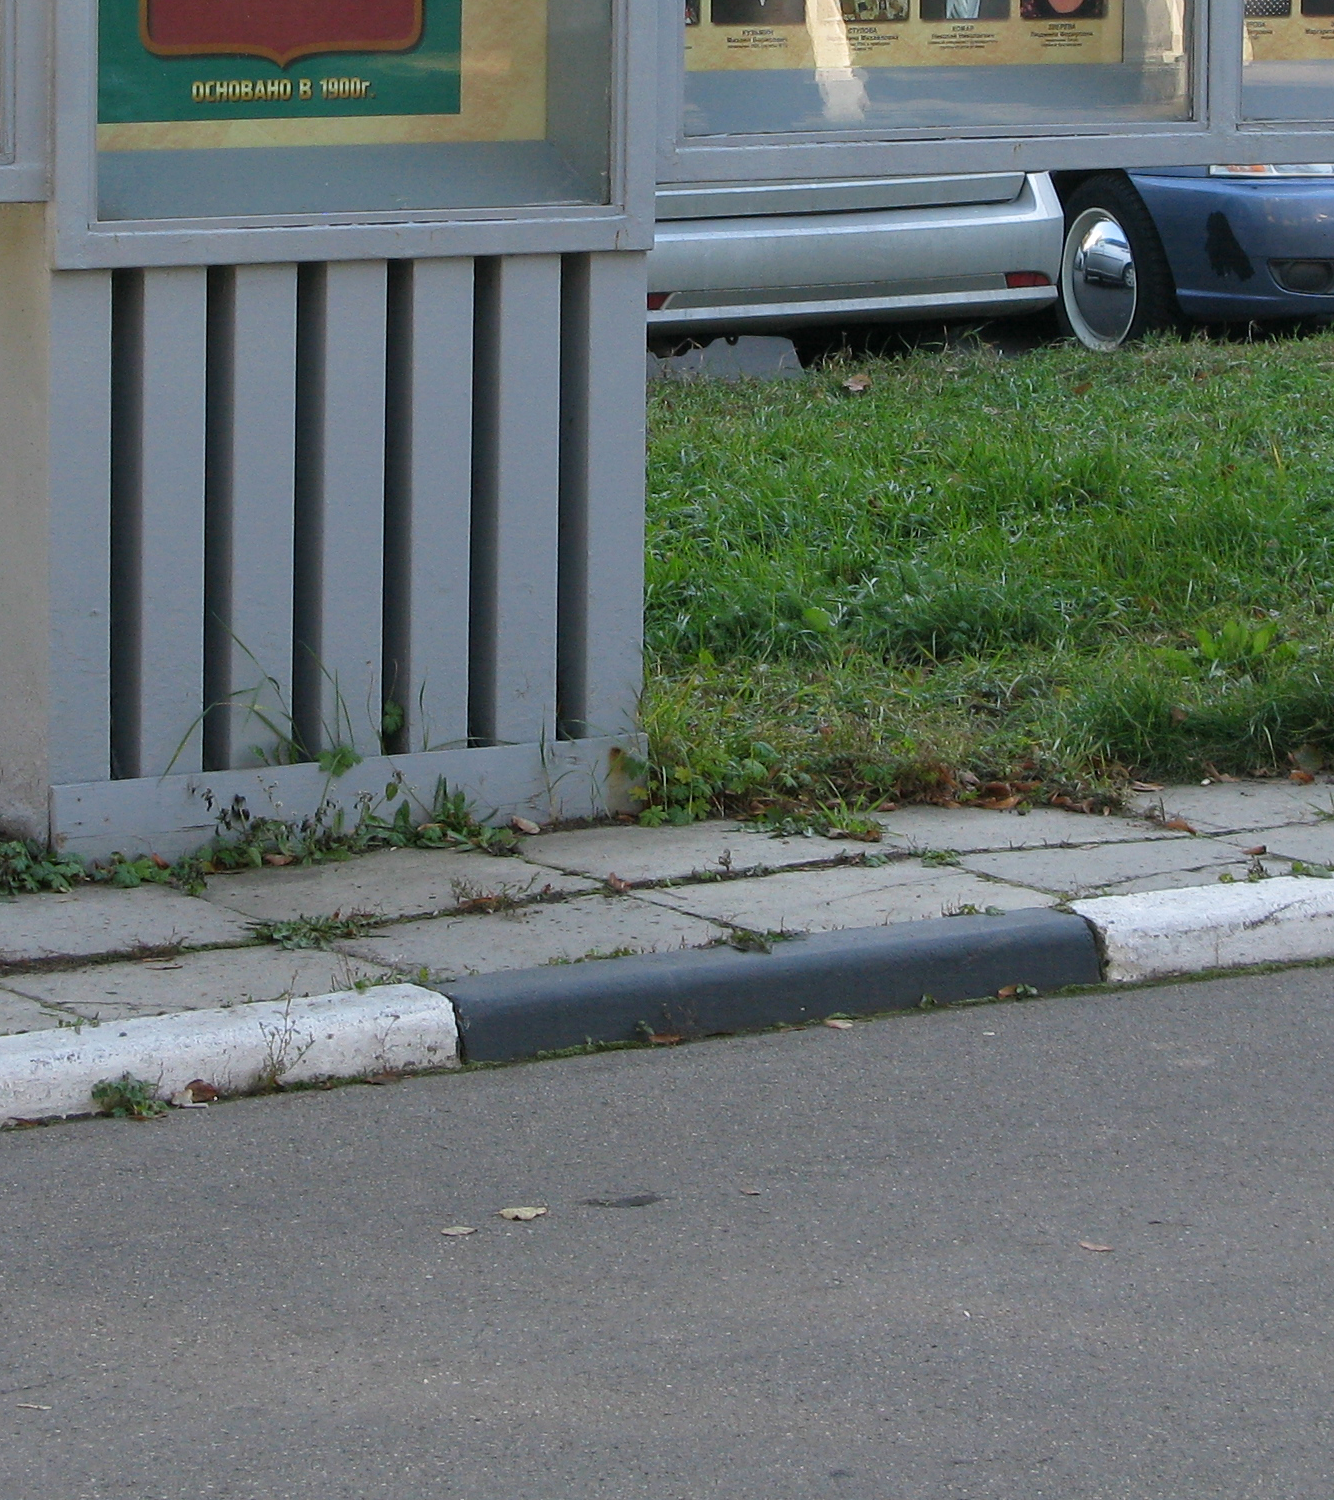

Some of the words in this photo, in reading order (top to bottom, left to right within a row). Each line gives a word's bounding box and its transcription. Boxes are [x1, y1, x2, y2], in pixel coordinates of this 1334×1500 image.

[191, 79, 292, 102] ОСНОВАНО
[299, 78, 313, 100] В
[319, 77, 376, 100] 1900г.
